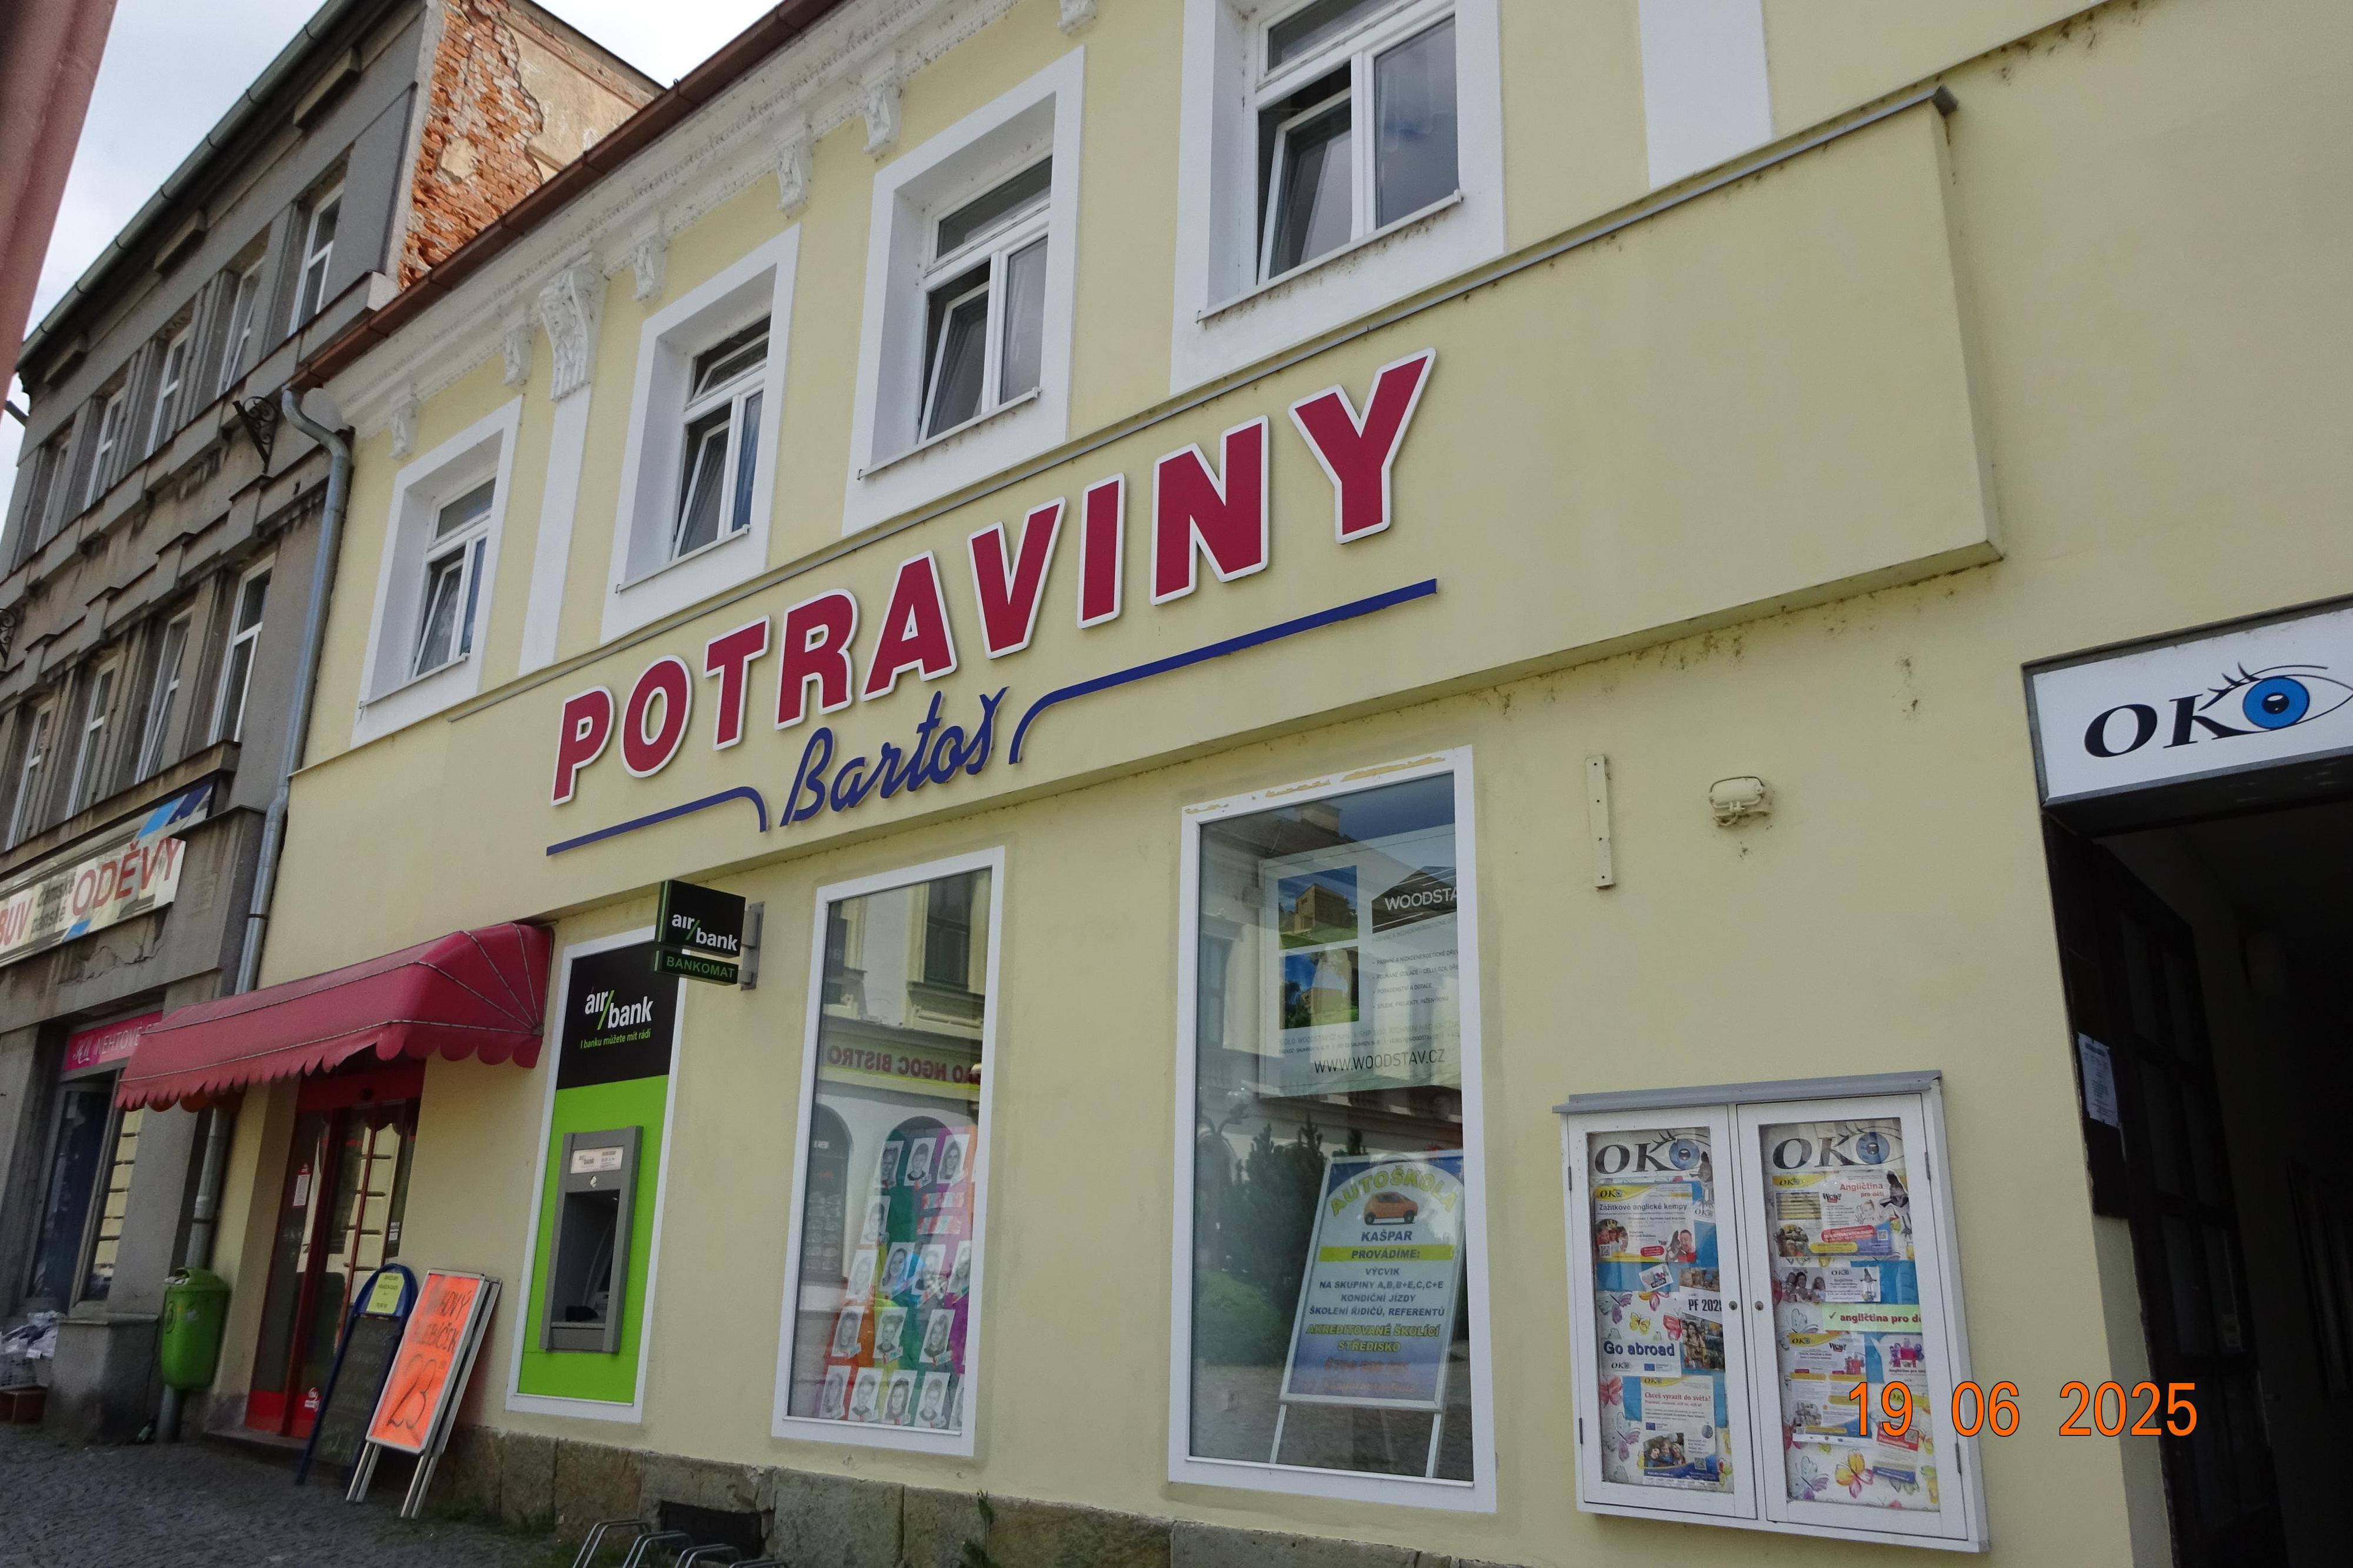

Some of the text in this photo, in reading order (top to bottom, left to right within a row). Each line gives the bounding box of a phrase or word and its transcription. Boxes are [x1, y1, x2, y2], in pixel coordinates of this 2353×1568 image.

[549, 347, 1436, 806] POTRAVINY
[779, 686, 1009, 827] Bartoš
[73, 838, 182, 916] ODĚVY
[695, 927, 738, 951] bank
[666, 956, 735, 979] BANKOMAT
[608, 996, 654, 1028] bank
[584, 1037, 602, 1049] banku
[603, 1033, 626, 1046] můžete
[627, 1030, 638, 1042] mít
[638, 1028, 651, 1040] rádi
[1314, 1049, 1445, 1073] WWW.WOODSTAV.CZ
[1331, 1165, 1458, 1217] AUTOŠKOLA
[1840, 1182, 1883, 1192] Angličtina
[1632, 1203, 1662, 1212] anglické
[1664, 1203, 1687, 1212] kempy
[1361, 1229, 1412, 1242] KAŠPAR
[1351, 1247, 1421, 1259] PROVÁDÍME:
[1365, 1266, 1400, 1276] VÝCVIK
[1319, 1281, 1331, 1289] NA
[1334, 1280, 1375, 1289] SKUPINY
[1688, 1299, 1699, 1311] PF
[1840, 1313, 1888, 1323] angličtina
[1891, 1315, 1909, 1324] pro
[1306, 1323, 1392, 1336] AKREDITOVANÉ
[1337, 1338, 1401, 1352] STŘEDISKO
[1604, 1340, 1675, 1356] Go abroad
